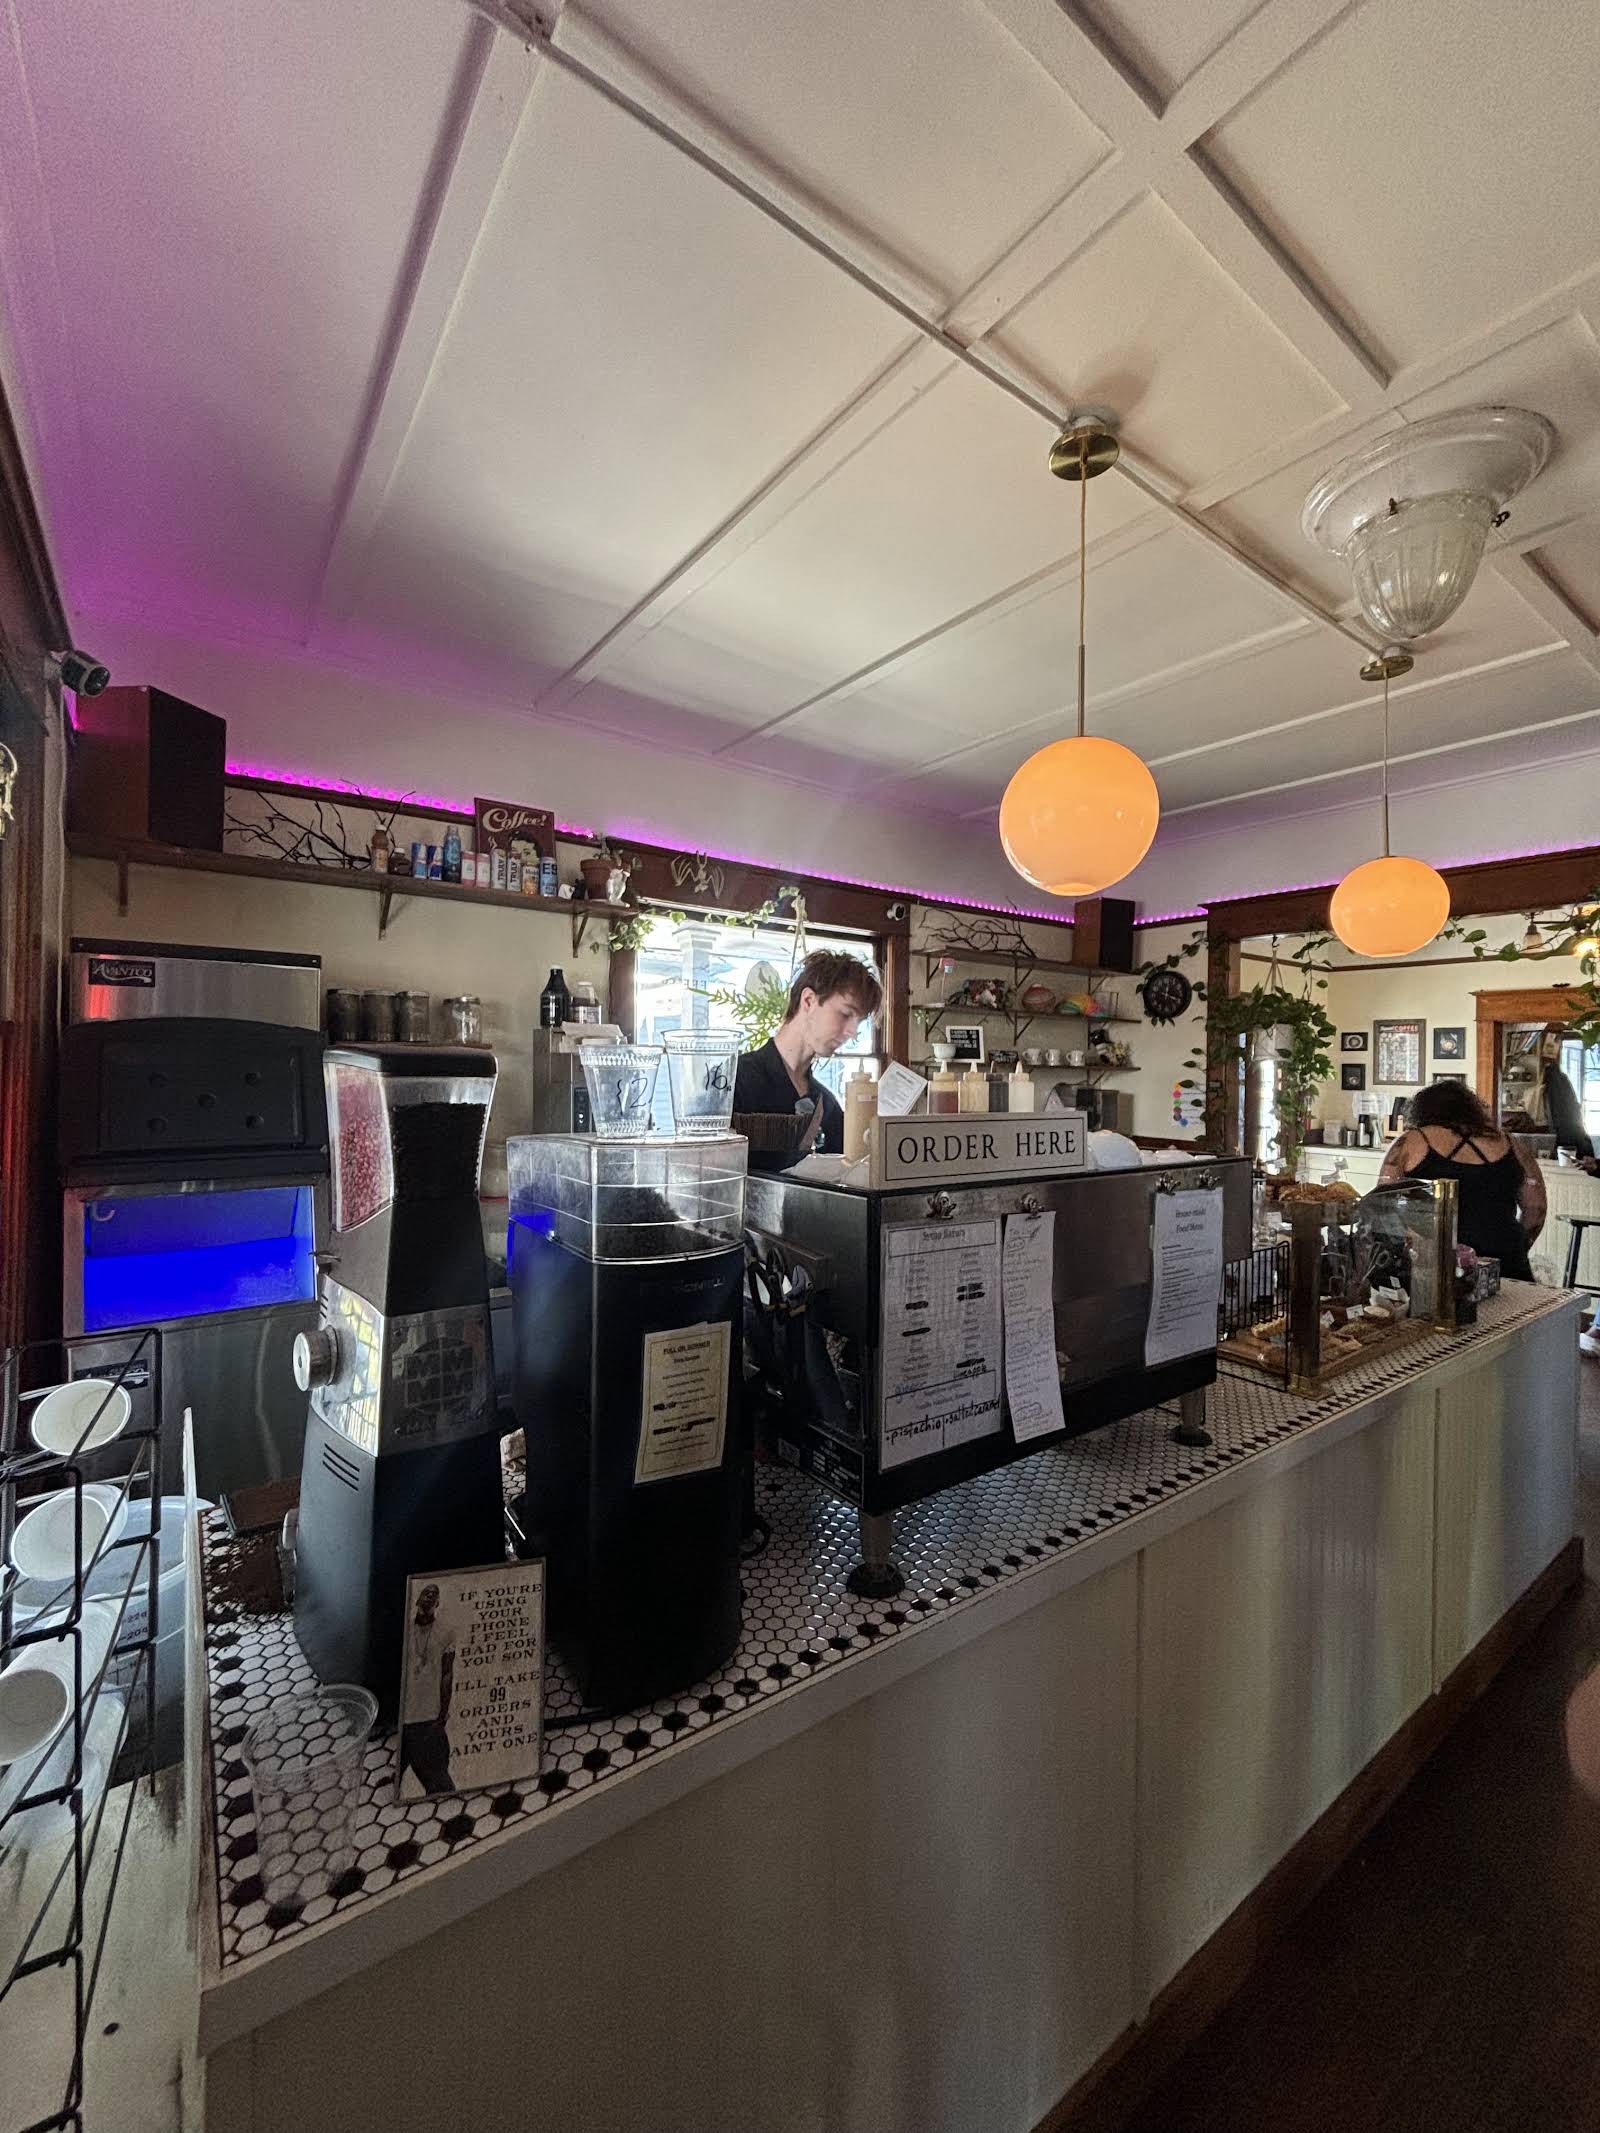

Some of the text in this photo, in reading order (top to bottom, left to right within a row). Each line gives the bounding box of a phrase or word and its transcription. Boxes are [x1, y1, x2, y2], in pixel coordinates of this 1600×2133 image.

[482, 807, 547, 833] Coffee!
[497, 859, 505, 881] TRULY
[510, 861, 518, 883] TRULY
[897, 1130, 1077, 1164] ORDER HERE
[459, 1583, 542, 1602] IF YOU'RE
[474, 1595, 527, 1610] USING
[478, 1607, 522, 1620] YOUR
[470, 1617, 530, 1633] PHONE
[470, 1628, 529, 1645] I FEEL
[460, 1637, 537, 1657] BAD FOR
[462, 1648, 535, 1668] YOU SON
[454, 1671, 540, 1692] I'LL TAKE
[489, 1686, 506, 1703] 99
[460, 1699, 531, 1718] ORDERS
[477, 1714, 515, 1729] AND
[466, 1724, 523, 1742] YOURS
[449, 1732, 538, 1758] AIN'T ONE
